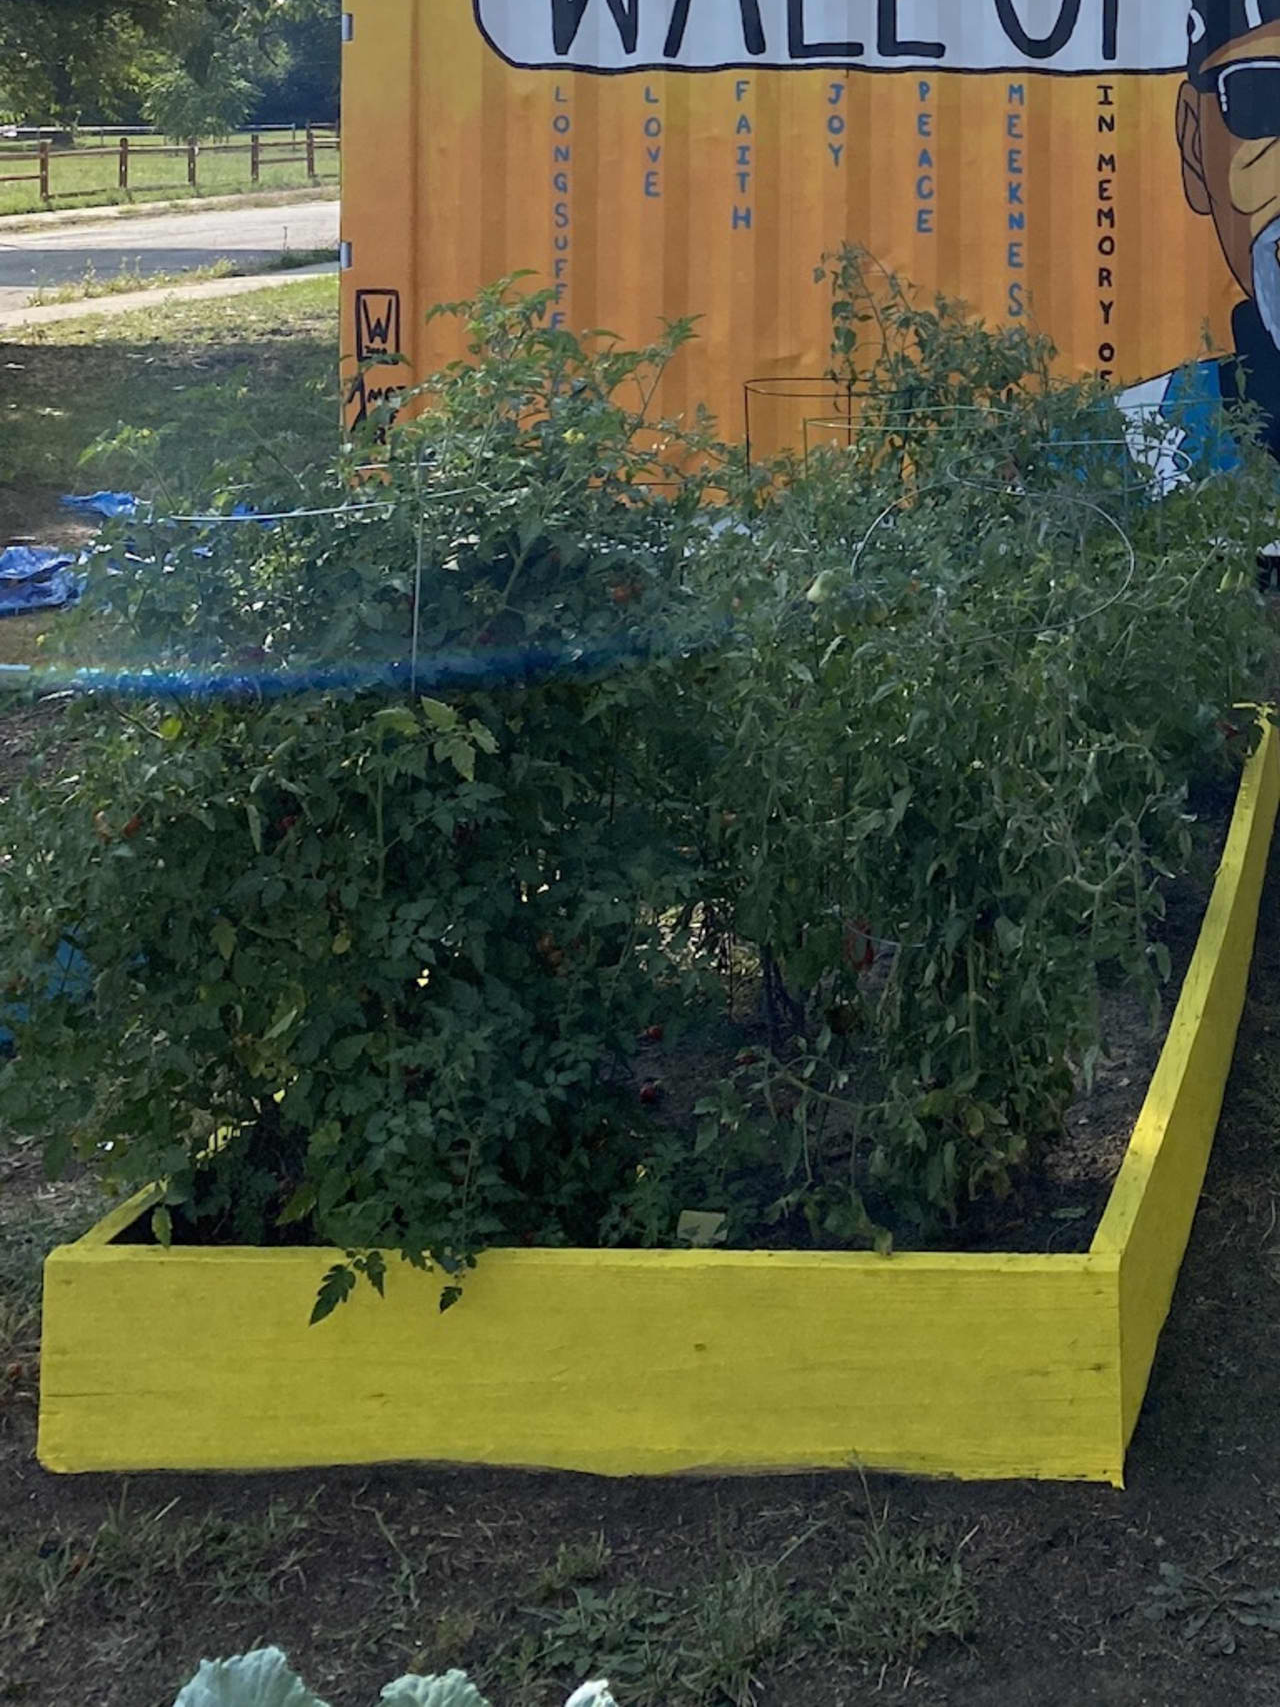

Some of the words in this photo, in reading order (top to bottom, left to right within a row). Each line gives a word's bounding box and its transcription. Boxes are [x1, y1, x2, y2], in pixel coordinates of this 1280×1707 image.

[643, 86, 663, 198] LOVE
[731, 80, 752, 230] FAITH
[827, 83, 845, 168] JOY
[915, 80, 935, 234] PEACE
[1096, 86, 1116, 133] IN
[1096, 154, 1118, 325] MEMORY
